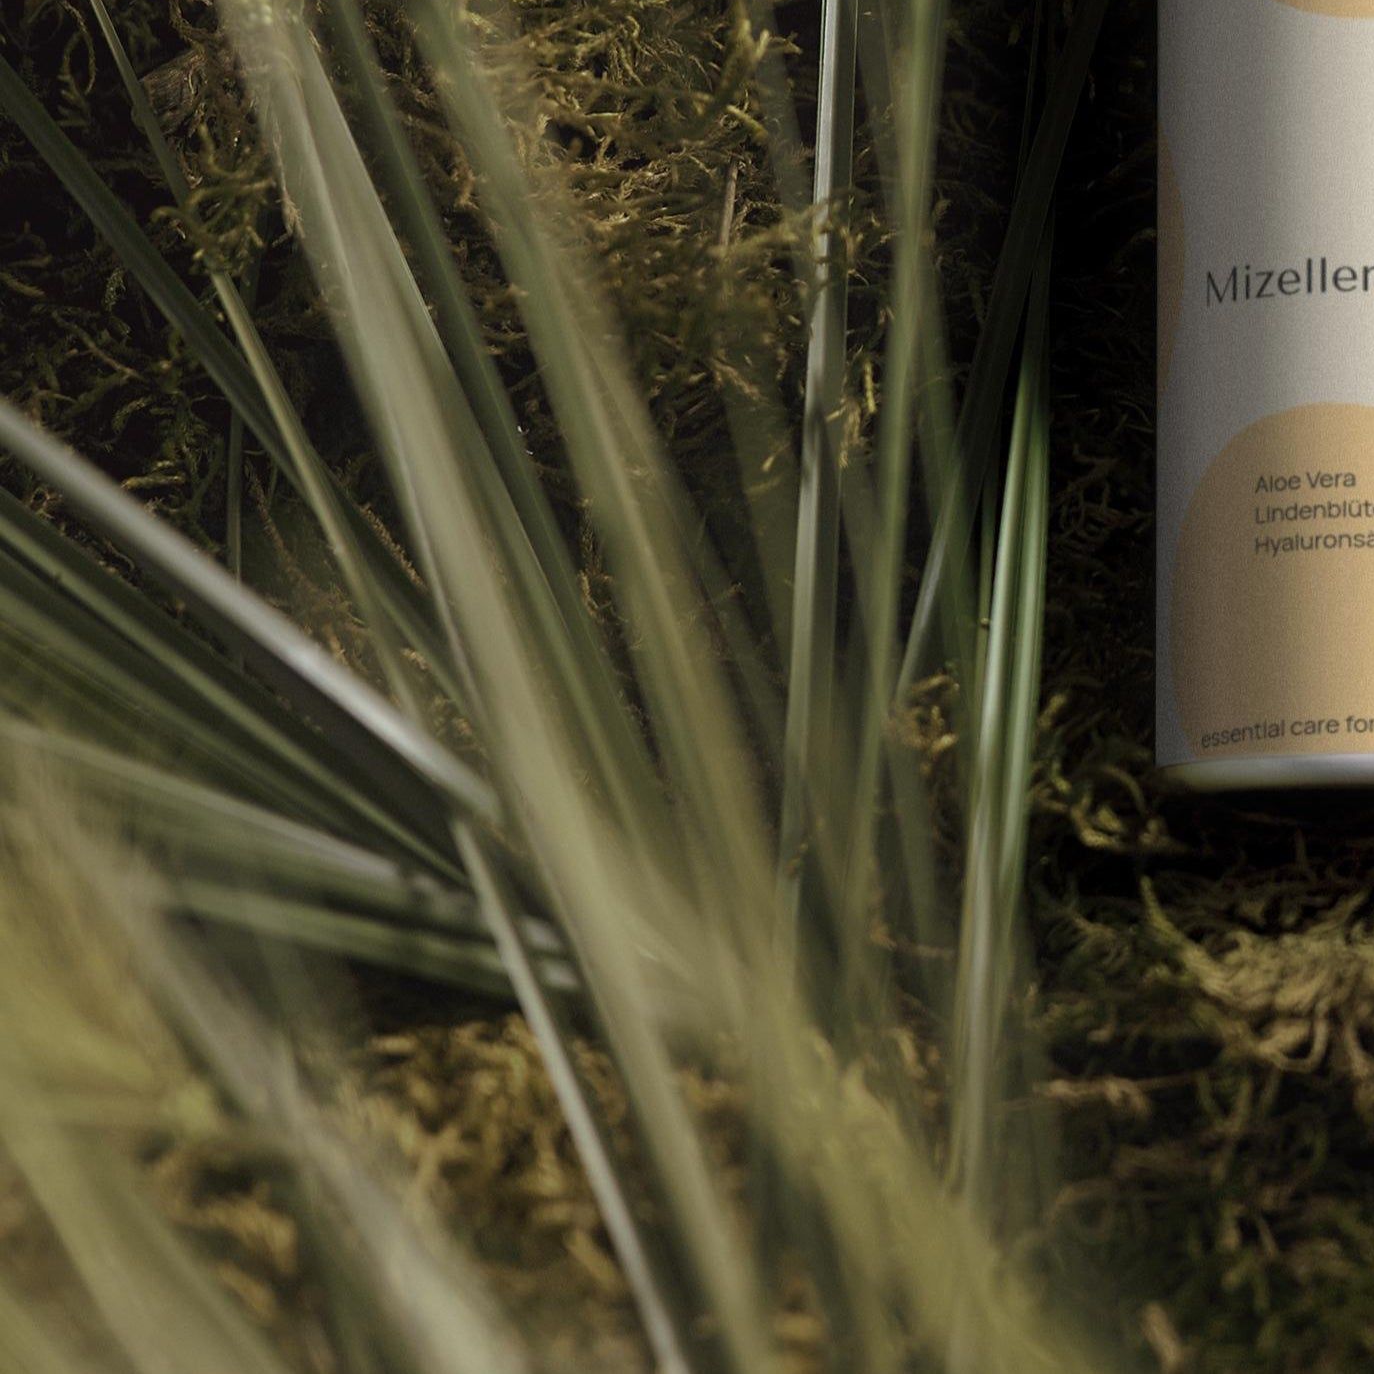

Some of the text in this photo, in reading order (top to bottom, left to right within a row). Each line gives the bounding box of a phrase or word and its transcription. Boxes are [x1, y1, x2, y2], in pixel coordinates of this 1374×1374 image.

[1254, 471, 1357, 494] Aloe Vera
[1200, 719, 1285, 749] essential
[1291, 717, 1340, 737] care
